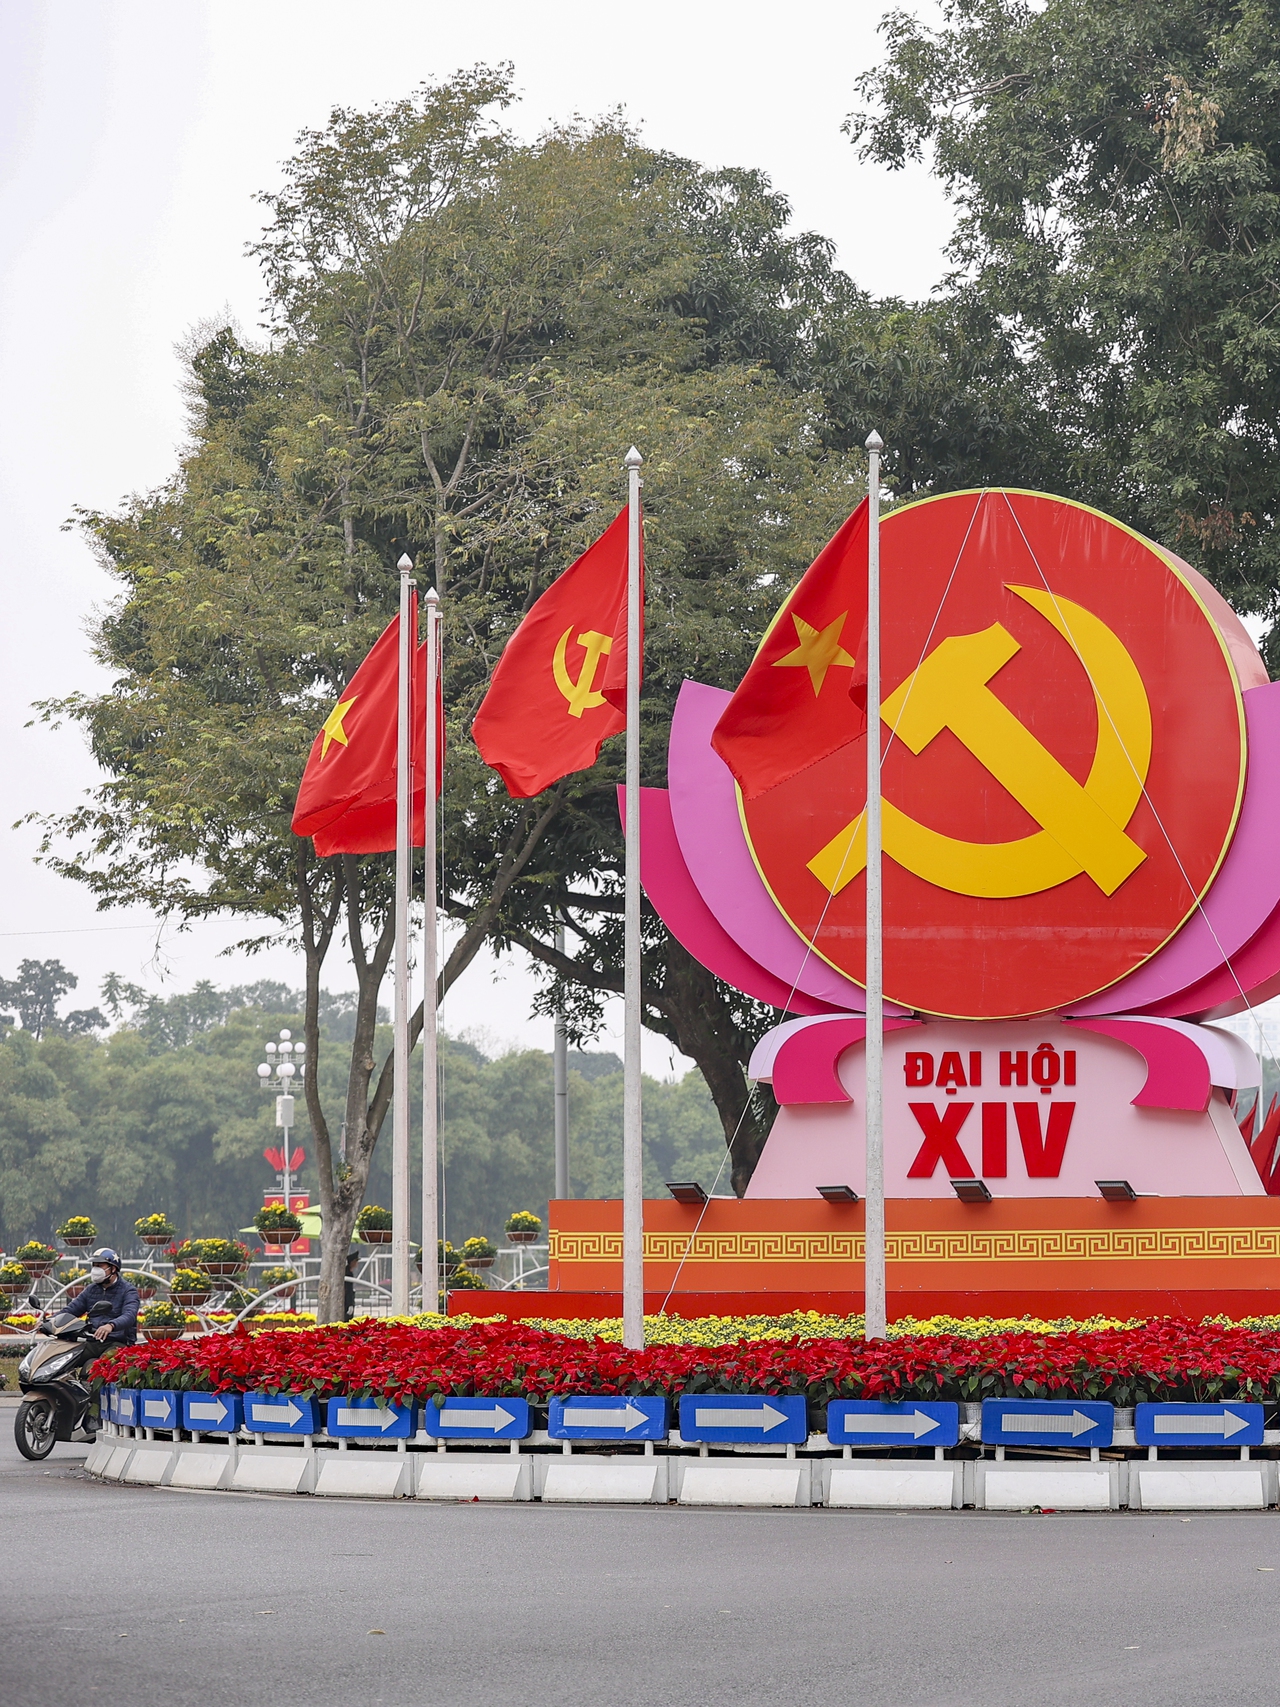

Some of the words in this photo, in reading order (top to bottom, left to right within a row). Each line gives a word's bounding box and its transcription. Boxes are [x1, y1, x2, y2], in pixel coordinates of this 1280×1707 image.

[904, 1051, 982, 1095] ĐẠI
[1000, 1043, 1077, 1094] HỘI
[907, 1101, 1076, 1178] XIV
